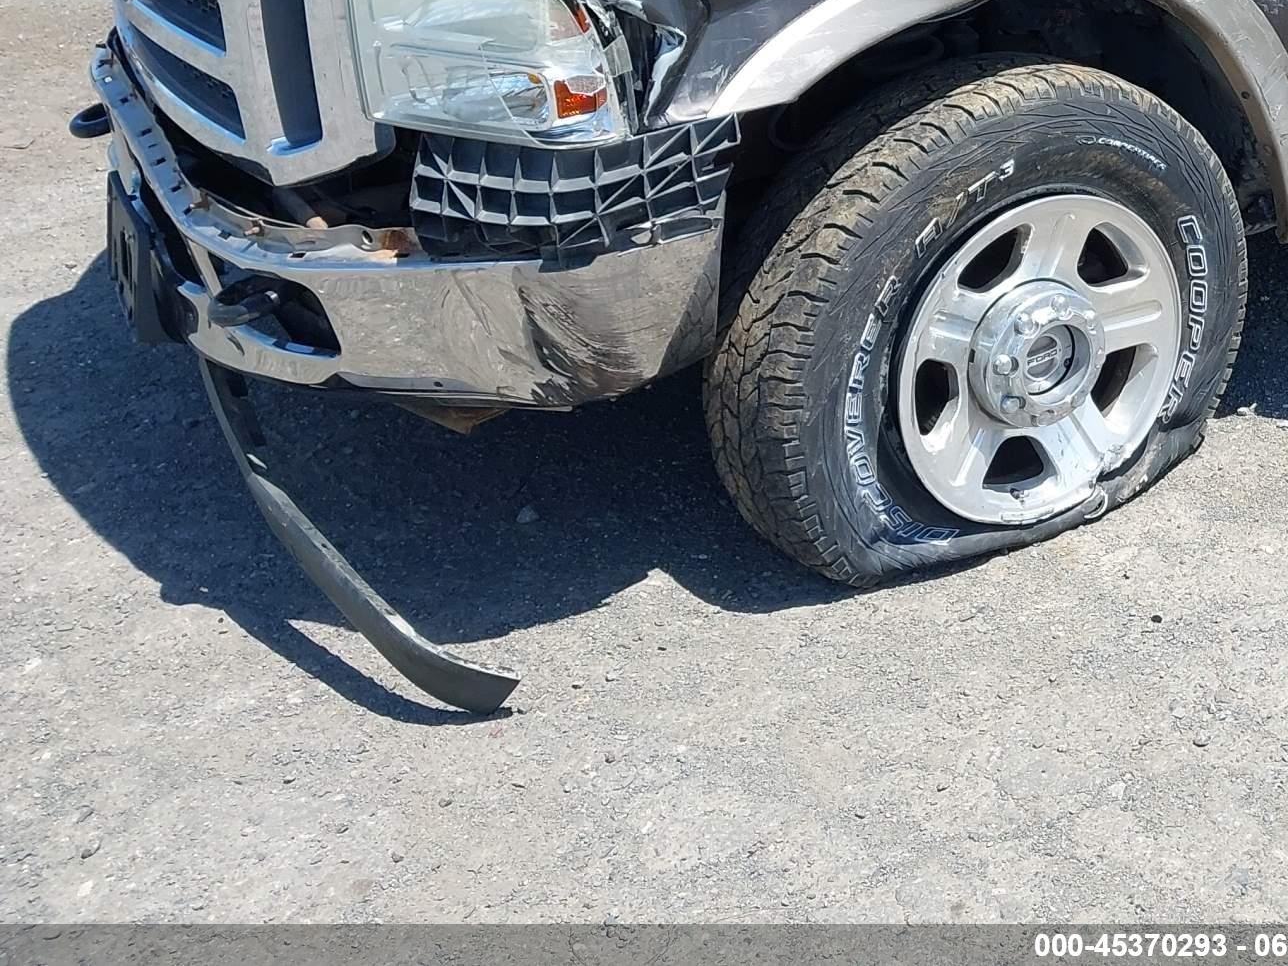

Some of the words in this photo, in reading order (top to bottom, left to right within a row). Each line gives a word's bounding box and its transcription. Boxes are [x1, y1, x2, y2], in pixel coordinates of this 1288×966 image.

[844, 275, 960, 546] DISCOVERER
[1026, 349, 1058, 366] FORD
[1157, 214, 1209, 425] COOPER
